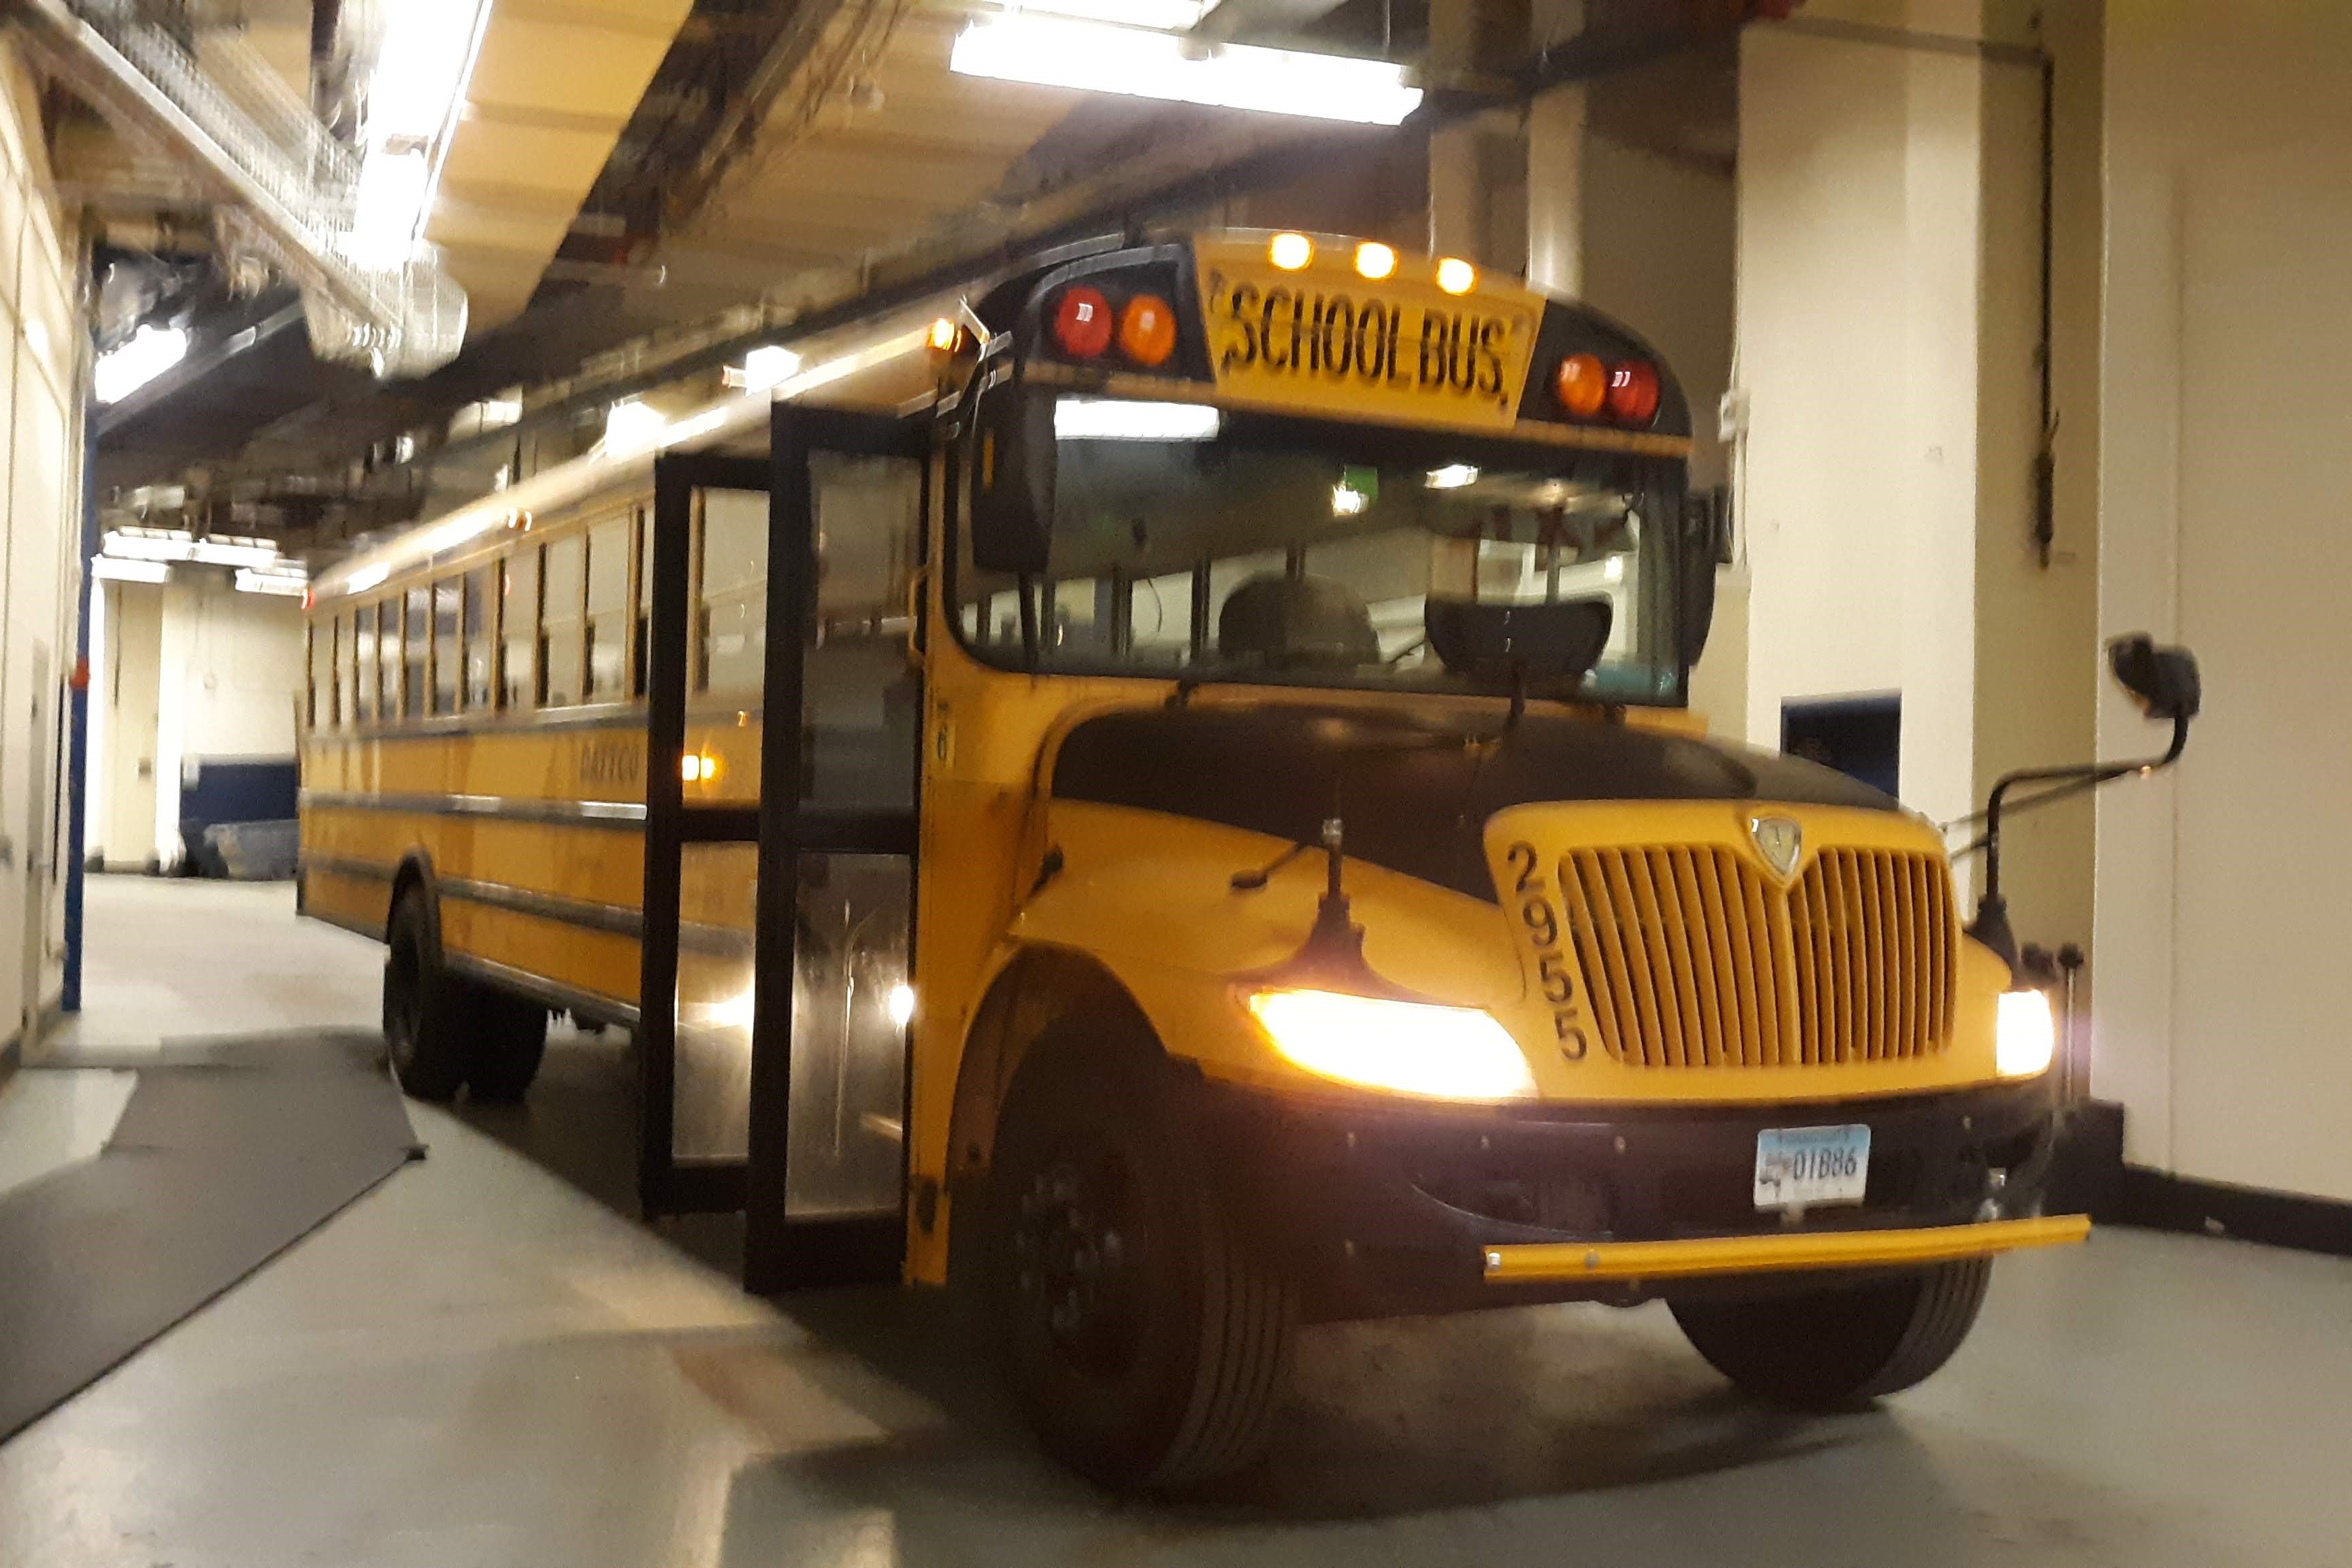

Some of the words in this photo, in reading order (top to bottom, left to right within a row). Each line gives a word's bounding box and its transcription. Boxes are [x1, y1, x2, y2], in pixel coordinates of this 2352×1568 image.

[1221, 281, 1412, 386] SCHOOL
[1419, 307, 1509, 407] BUS
[1507, 841, 1588, 1062] 29555
